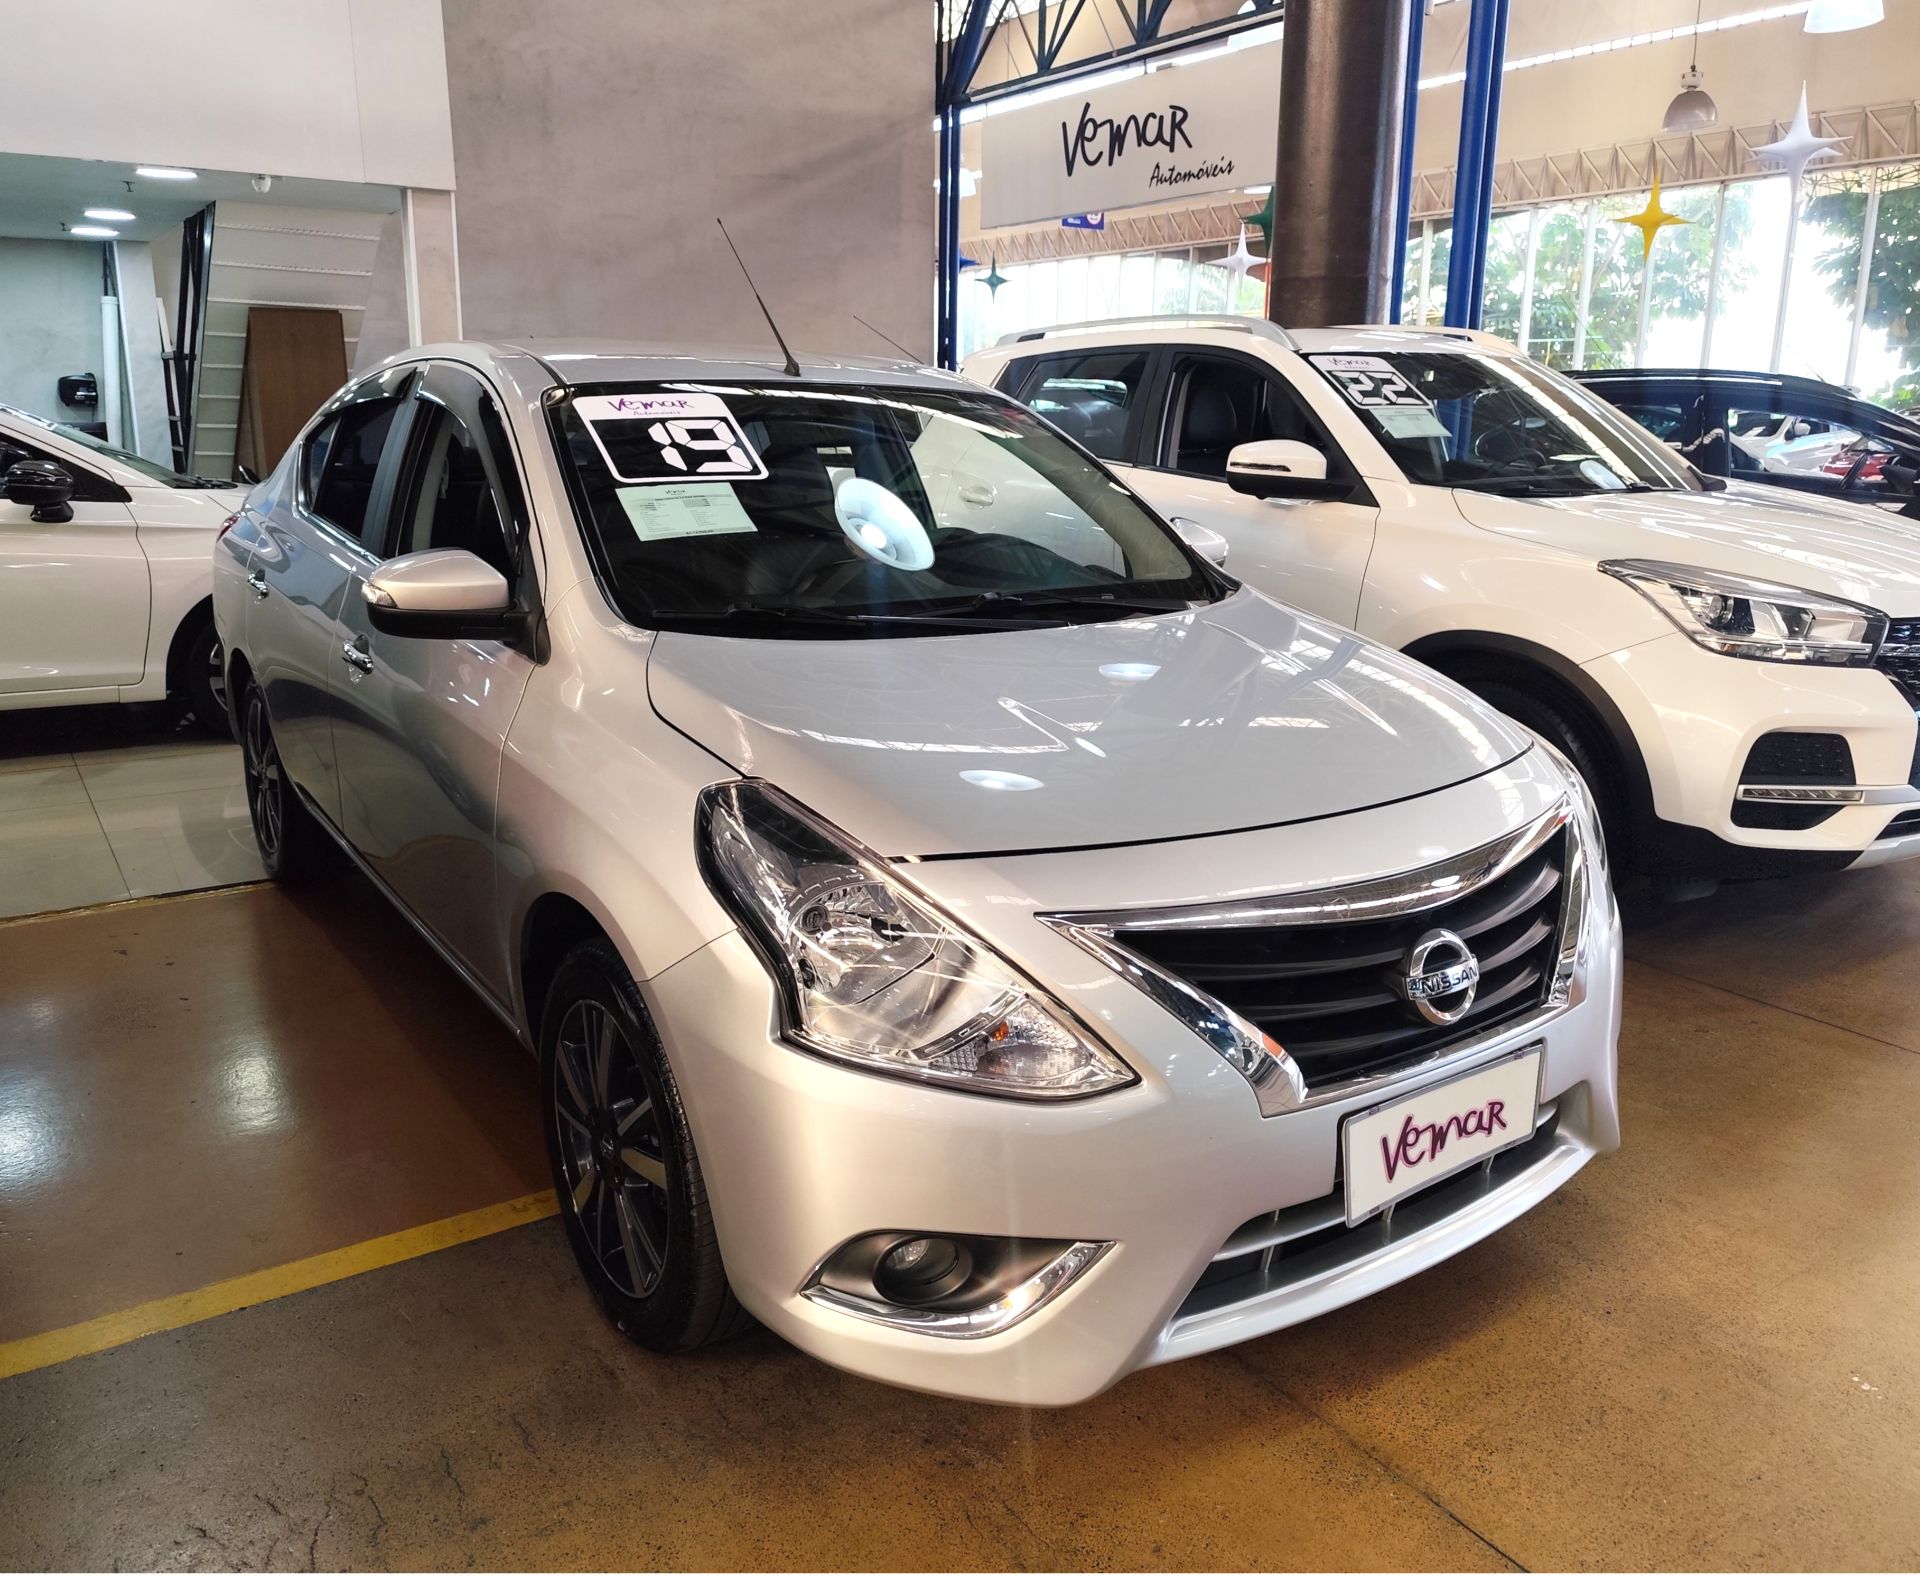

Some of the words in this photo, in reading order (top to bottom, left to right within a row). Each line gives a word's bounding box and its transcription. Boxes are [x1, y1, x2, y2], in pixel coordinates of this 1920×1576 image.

[1149, 155, 1235, 188] Automóveis
[1331, 371, 1425, 405] 22
[647, 419, 754, 473] 19
[1421, 966, 1478, 994] NISSAN
